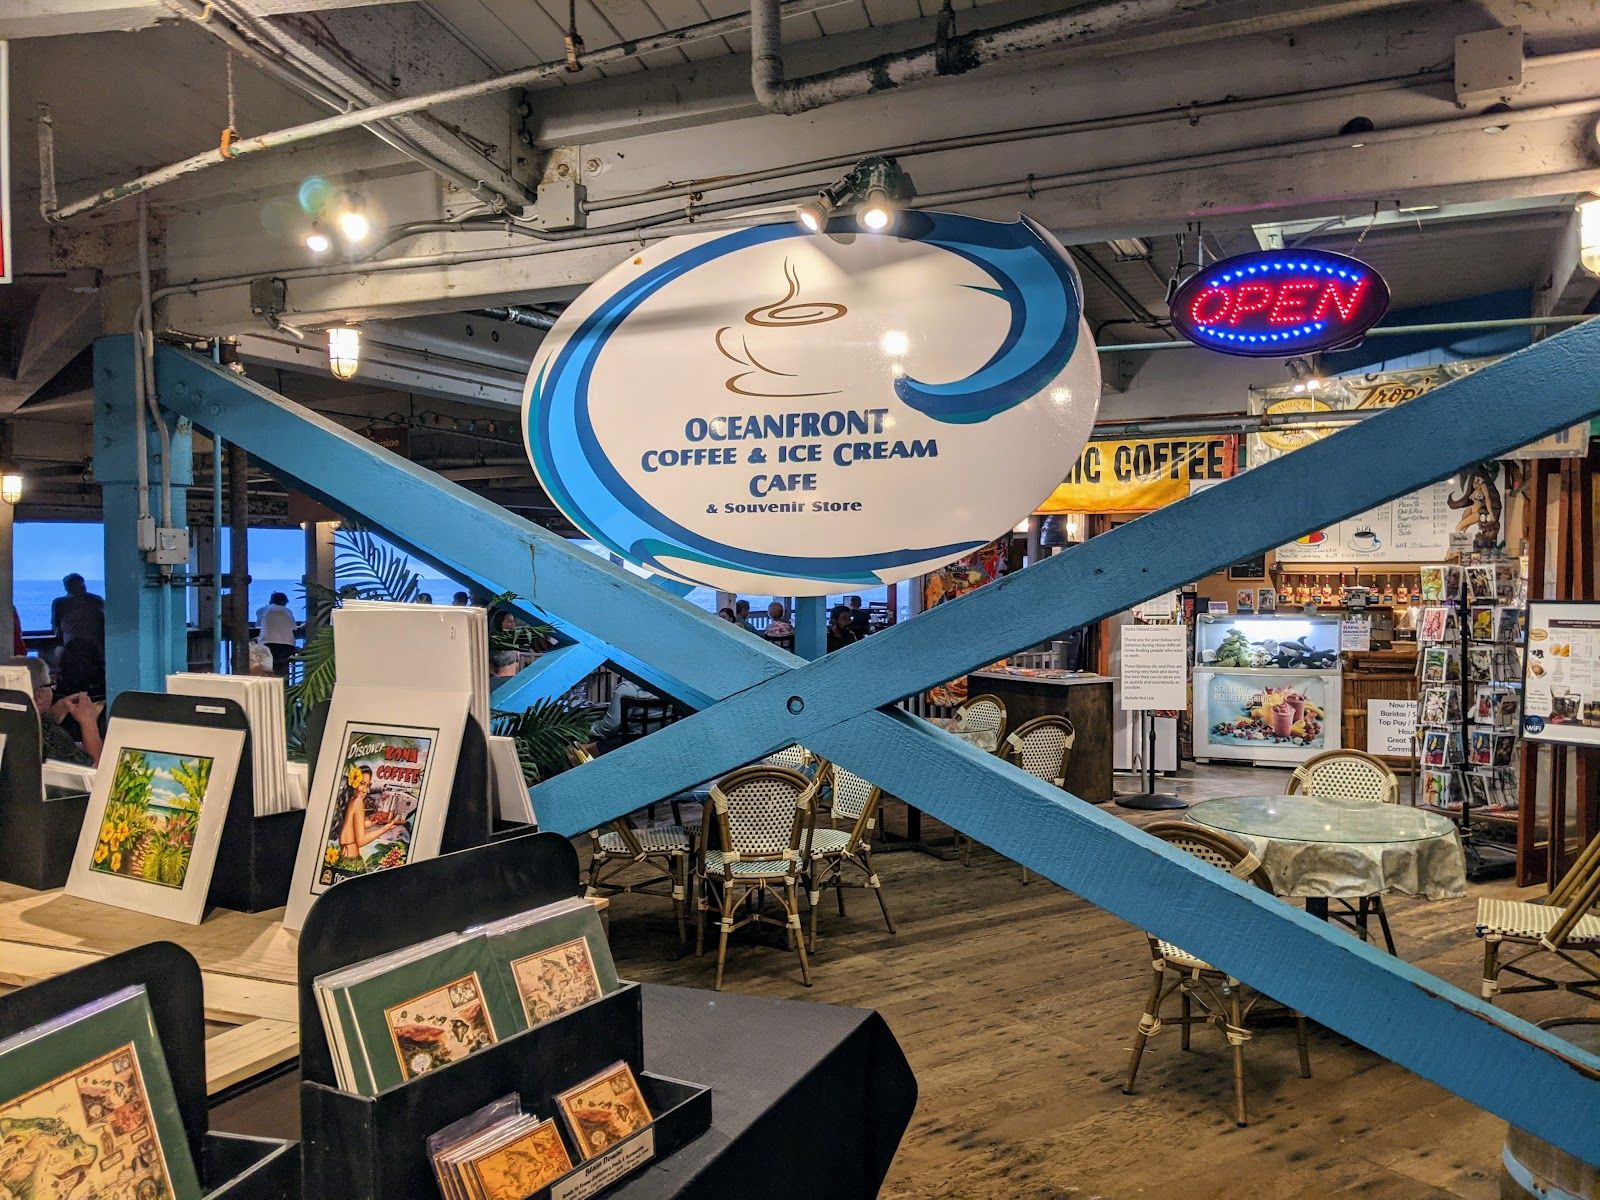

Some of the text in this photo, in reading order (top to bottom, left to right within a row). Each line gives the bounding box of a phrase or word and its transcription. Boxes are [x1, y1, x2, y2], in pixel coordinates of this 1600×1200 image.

[1191, 281, 1364, 325] OPEN
[1352, 377, 1436, 410] Tropi
[685, 408, 889, 442] OCEANFRONT
[641, 439, 938, 473] COFFEE & ICE CREAM
[1113, 440, 1225, 483] COFFEE
[749, 473, 817, 498] CAFE
[706, 500, 862, 514] & Souvenir Store
[348, 742, 418, 763] Discover KONA
[376, 765, 421, 784] COFFEE
